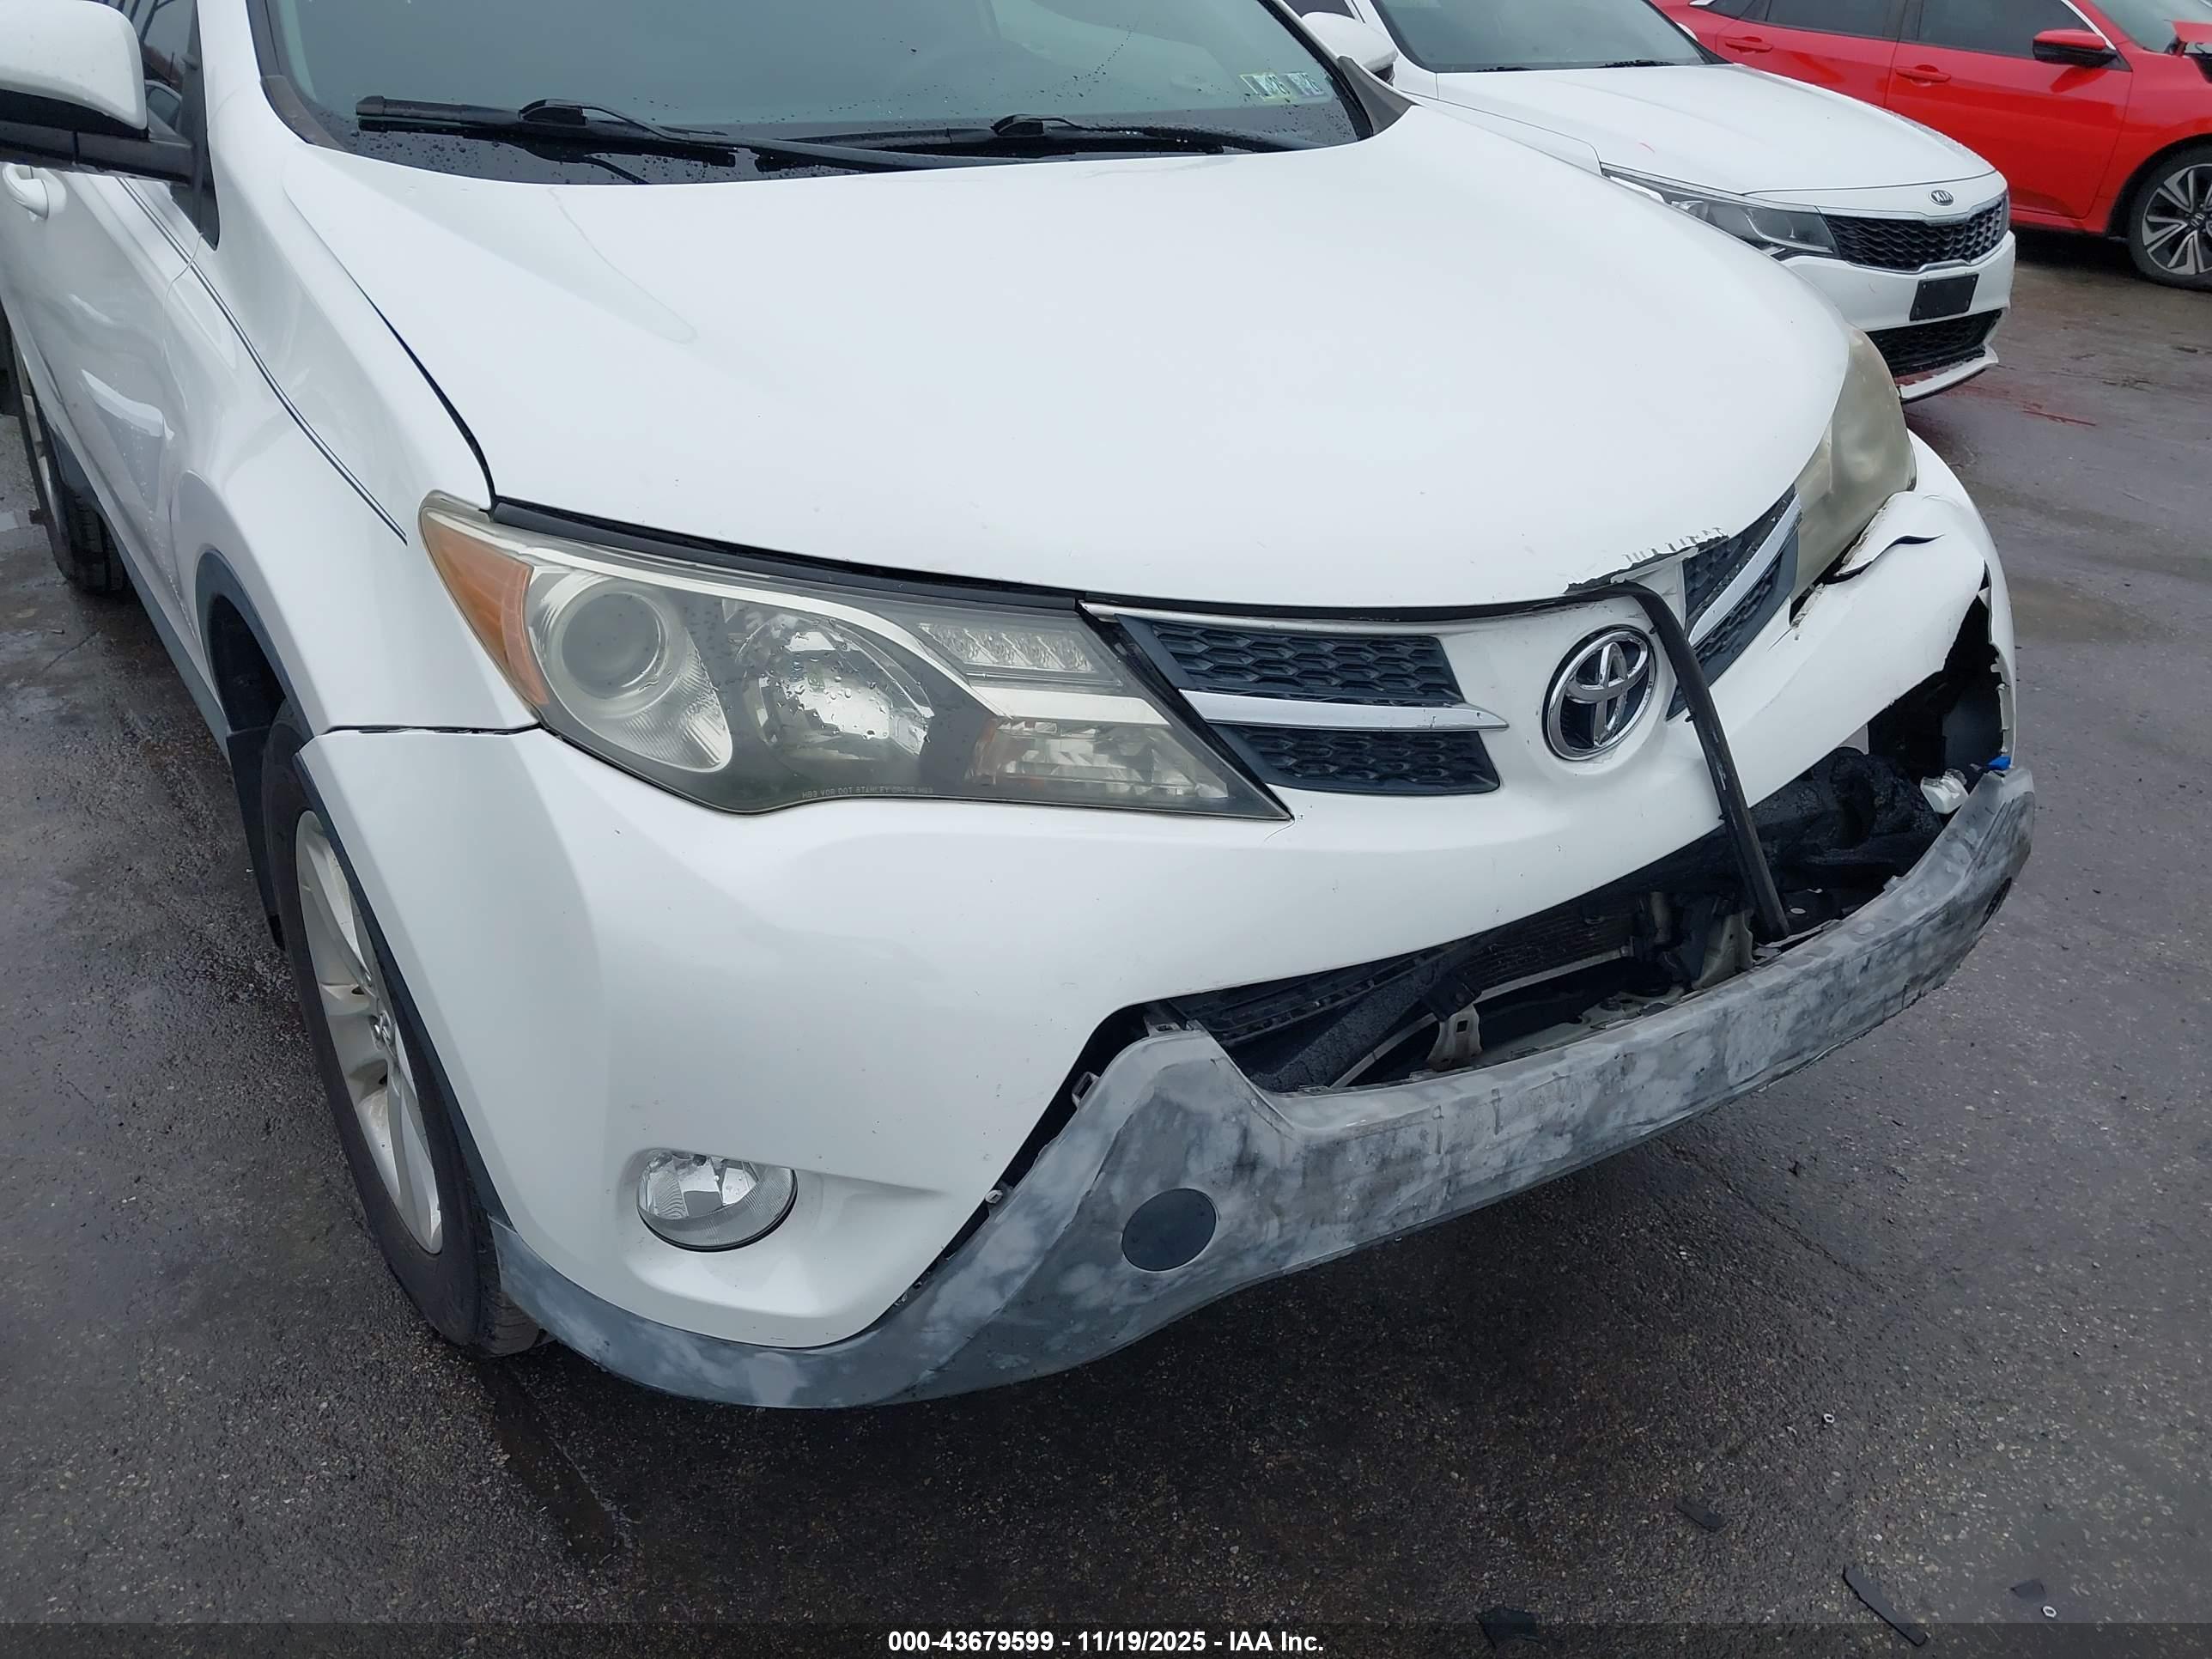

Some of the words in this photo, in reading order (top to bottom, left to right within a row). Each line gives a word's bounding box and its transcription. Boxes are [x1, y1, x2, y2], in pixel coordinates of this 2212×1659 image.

[1931, 191, 1953, 203] KIA
[838, 786, 853, 795] DOT
[856, 785, 888, 794] STANLEY
